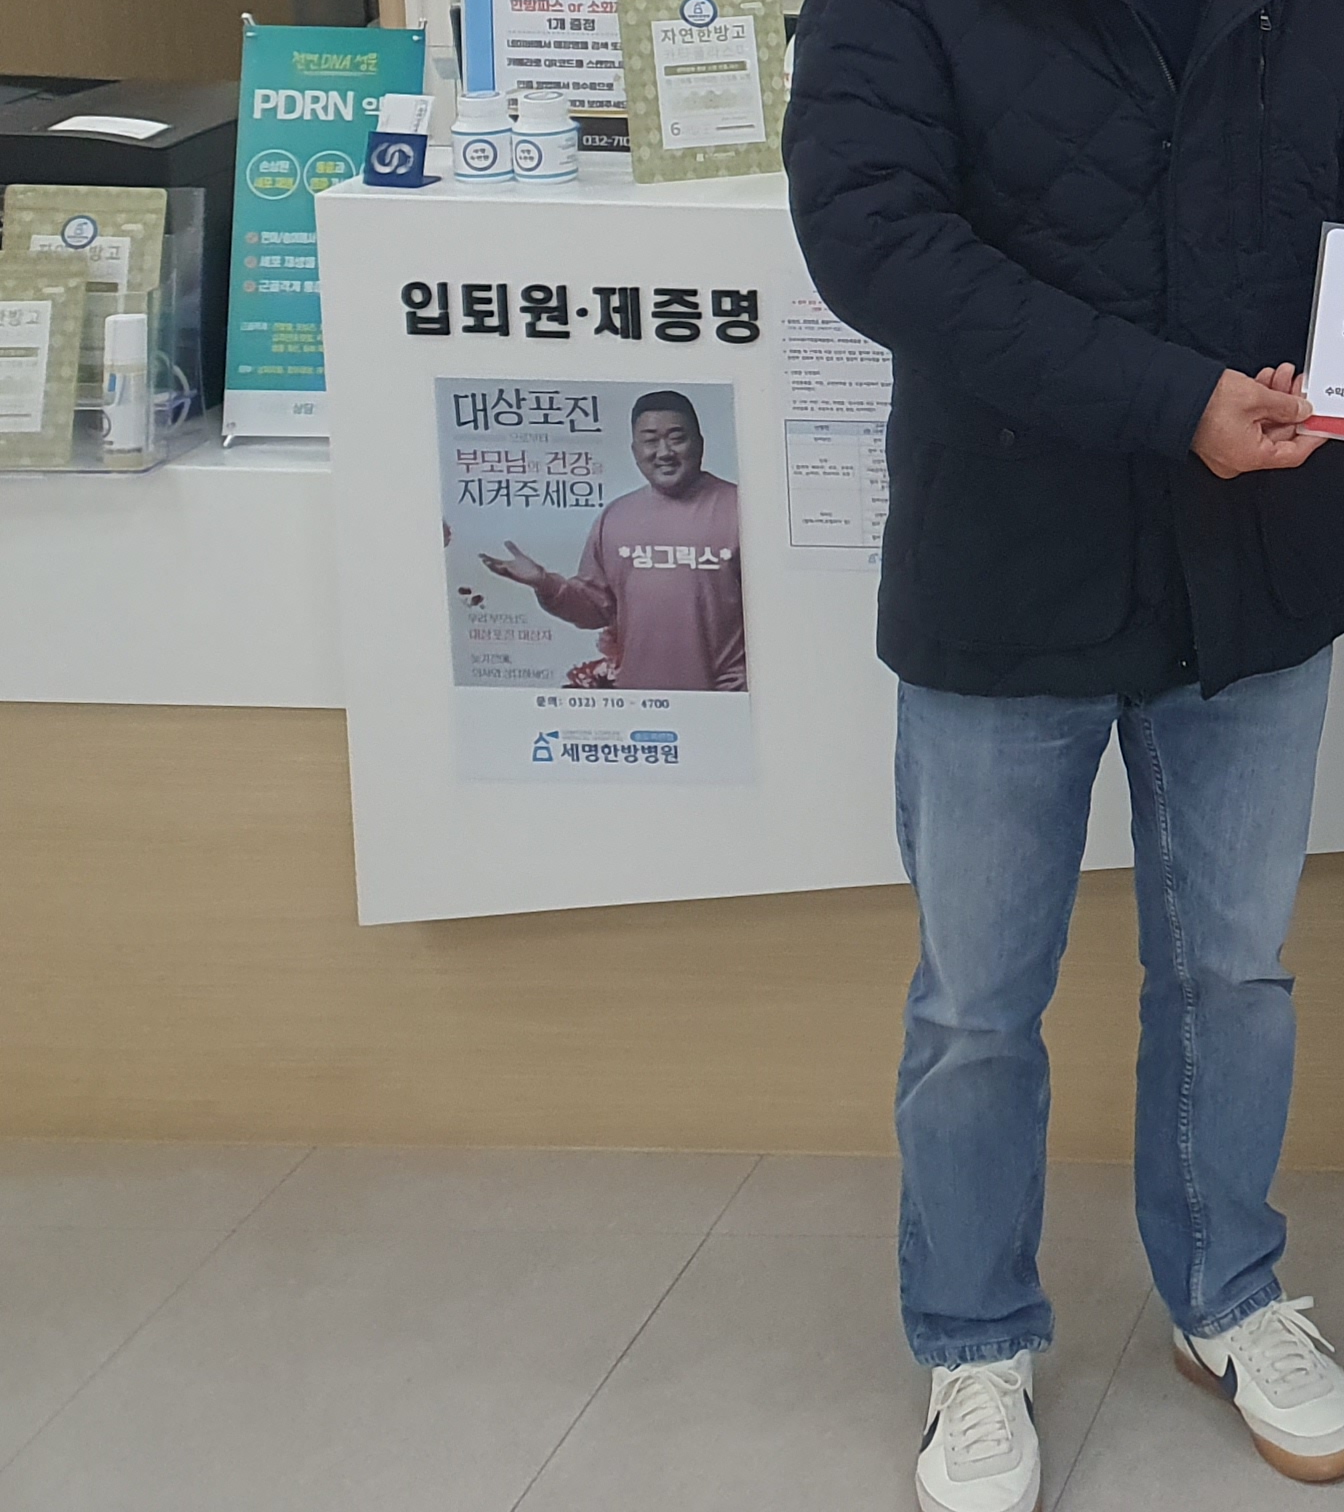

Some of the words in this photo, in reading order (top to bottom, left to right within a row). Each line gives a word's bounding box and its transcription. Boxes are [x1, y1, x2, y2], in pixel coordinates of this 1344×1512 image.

[567, 3, 584, 12] or
[253, 89, 354, 121] PDRN
[670, 122, 681, 137] 6
[401, 281, 760, 343] 입퇴원·제증명
[453, 388, 603, 433] 대상포진
[458, 478, 604, 508] 지켜주세요!
[568, 697, 596, 708] 032)
[602, 698, 624, 709] 710
[641, 699, 669, 709] 4700
[561, 743, 679, 764] 세명한방병원
